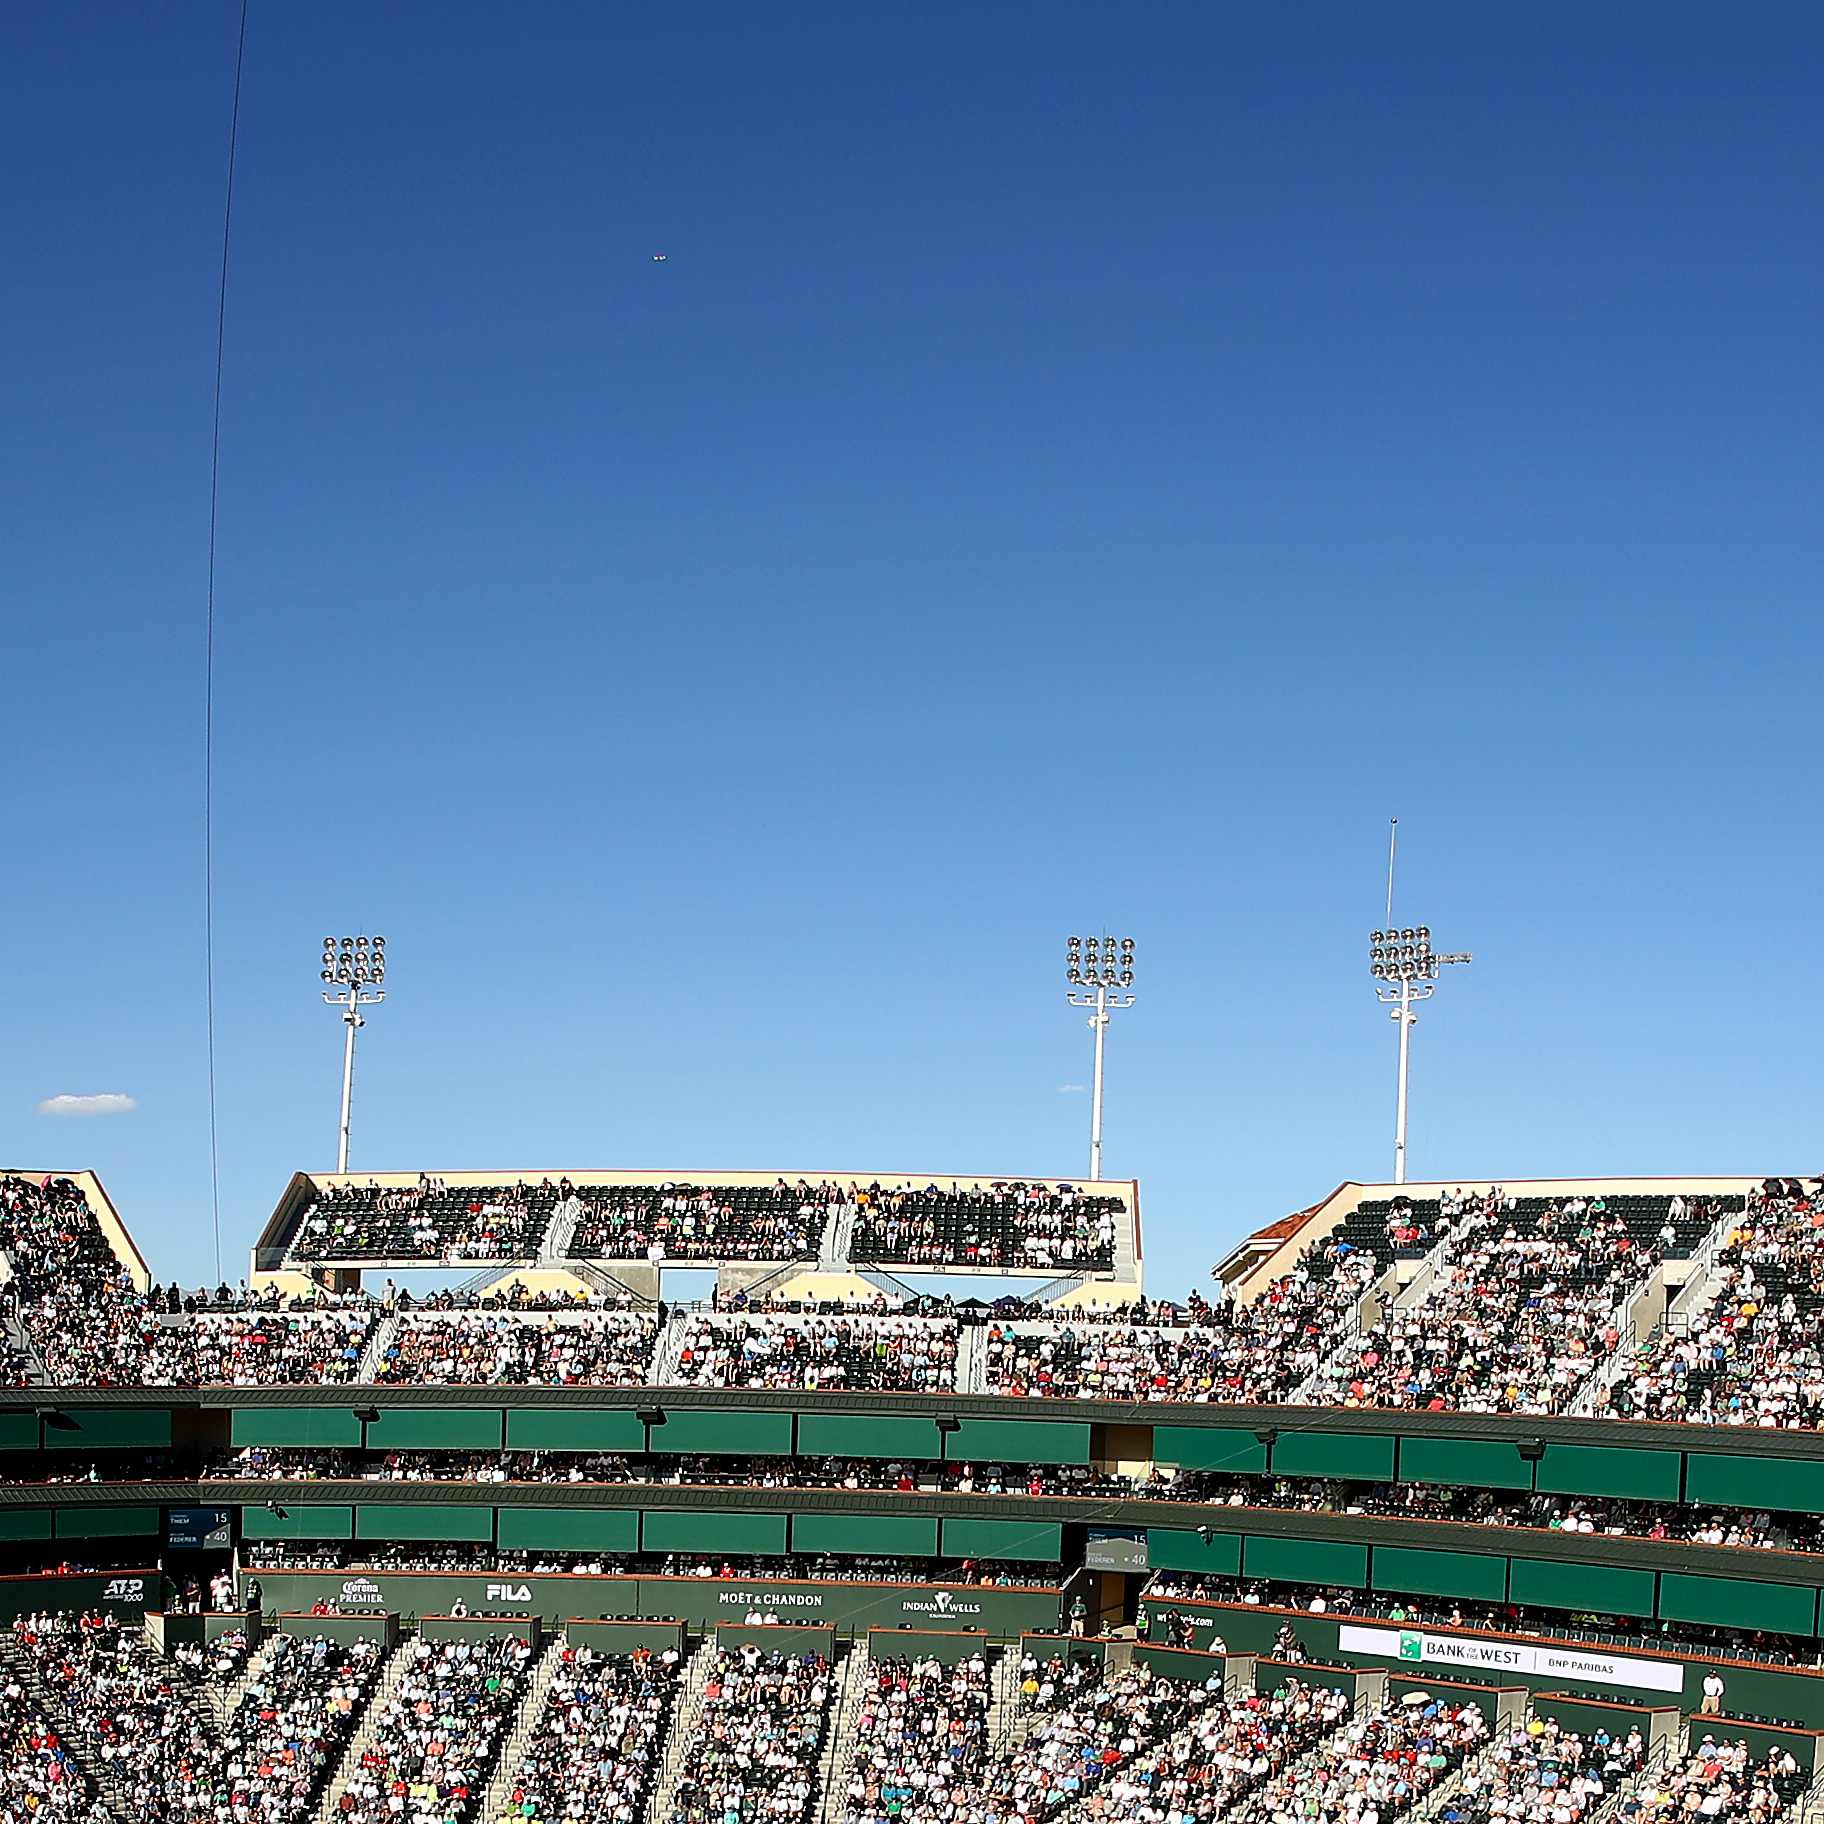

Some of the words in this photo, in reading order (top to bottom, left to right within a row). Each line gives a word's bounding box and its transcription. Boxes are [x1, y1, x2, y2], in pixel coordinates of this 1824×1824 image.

[214, 1513, 227, 1523] 15
[214, 1531, 227, 1541] 40
[1133, 1535, 1146, 1545] 15
[104, 1579, 143, 1594] ATP
[342, 1582, 379, 1594] Corona
[486, 1584, 532, 1601] FILA
[123, 1594, 143, 1602] 1000
[339, 1593, 384, 1603] PREMIER
[719, 1592, 753, 1605] MOËT
[764, 1593, 823, 1606] CHANDON
[902, 1601, 938, 1611] INDIAN
[949, 1602, 981, 1613] WELLS
[1426, 1641, 1465, 1658] BANK
[1480, 1648, 1521, 1665] WEST
[1548, 1658, 1569, 1668] BNP
[1571, 1660, 1615, 1675] PARIBAS
